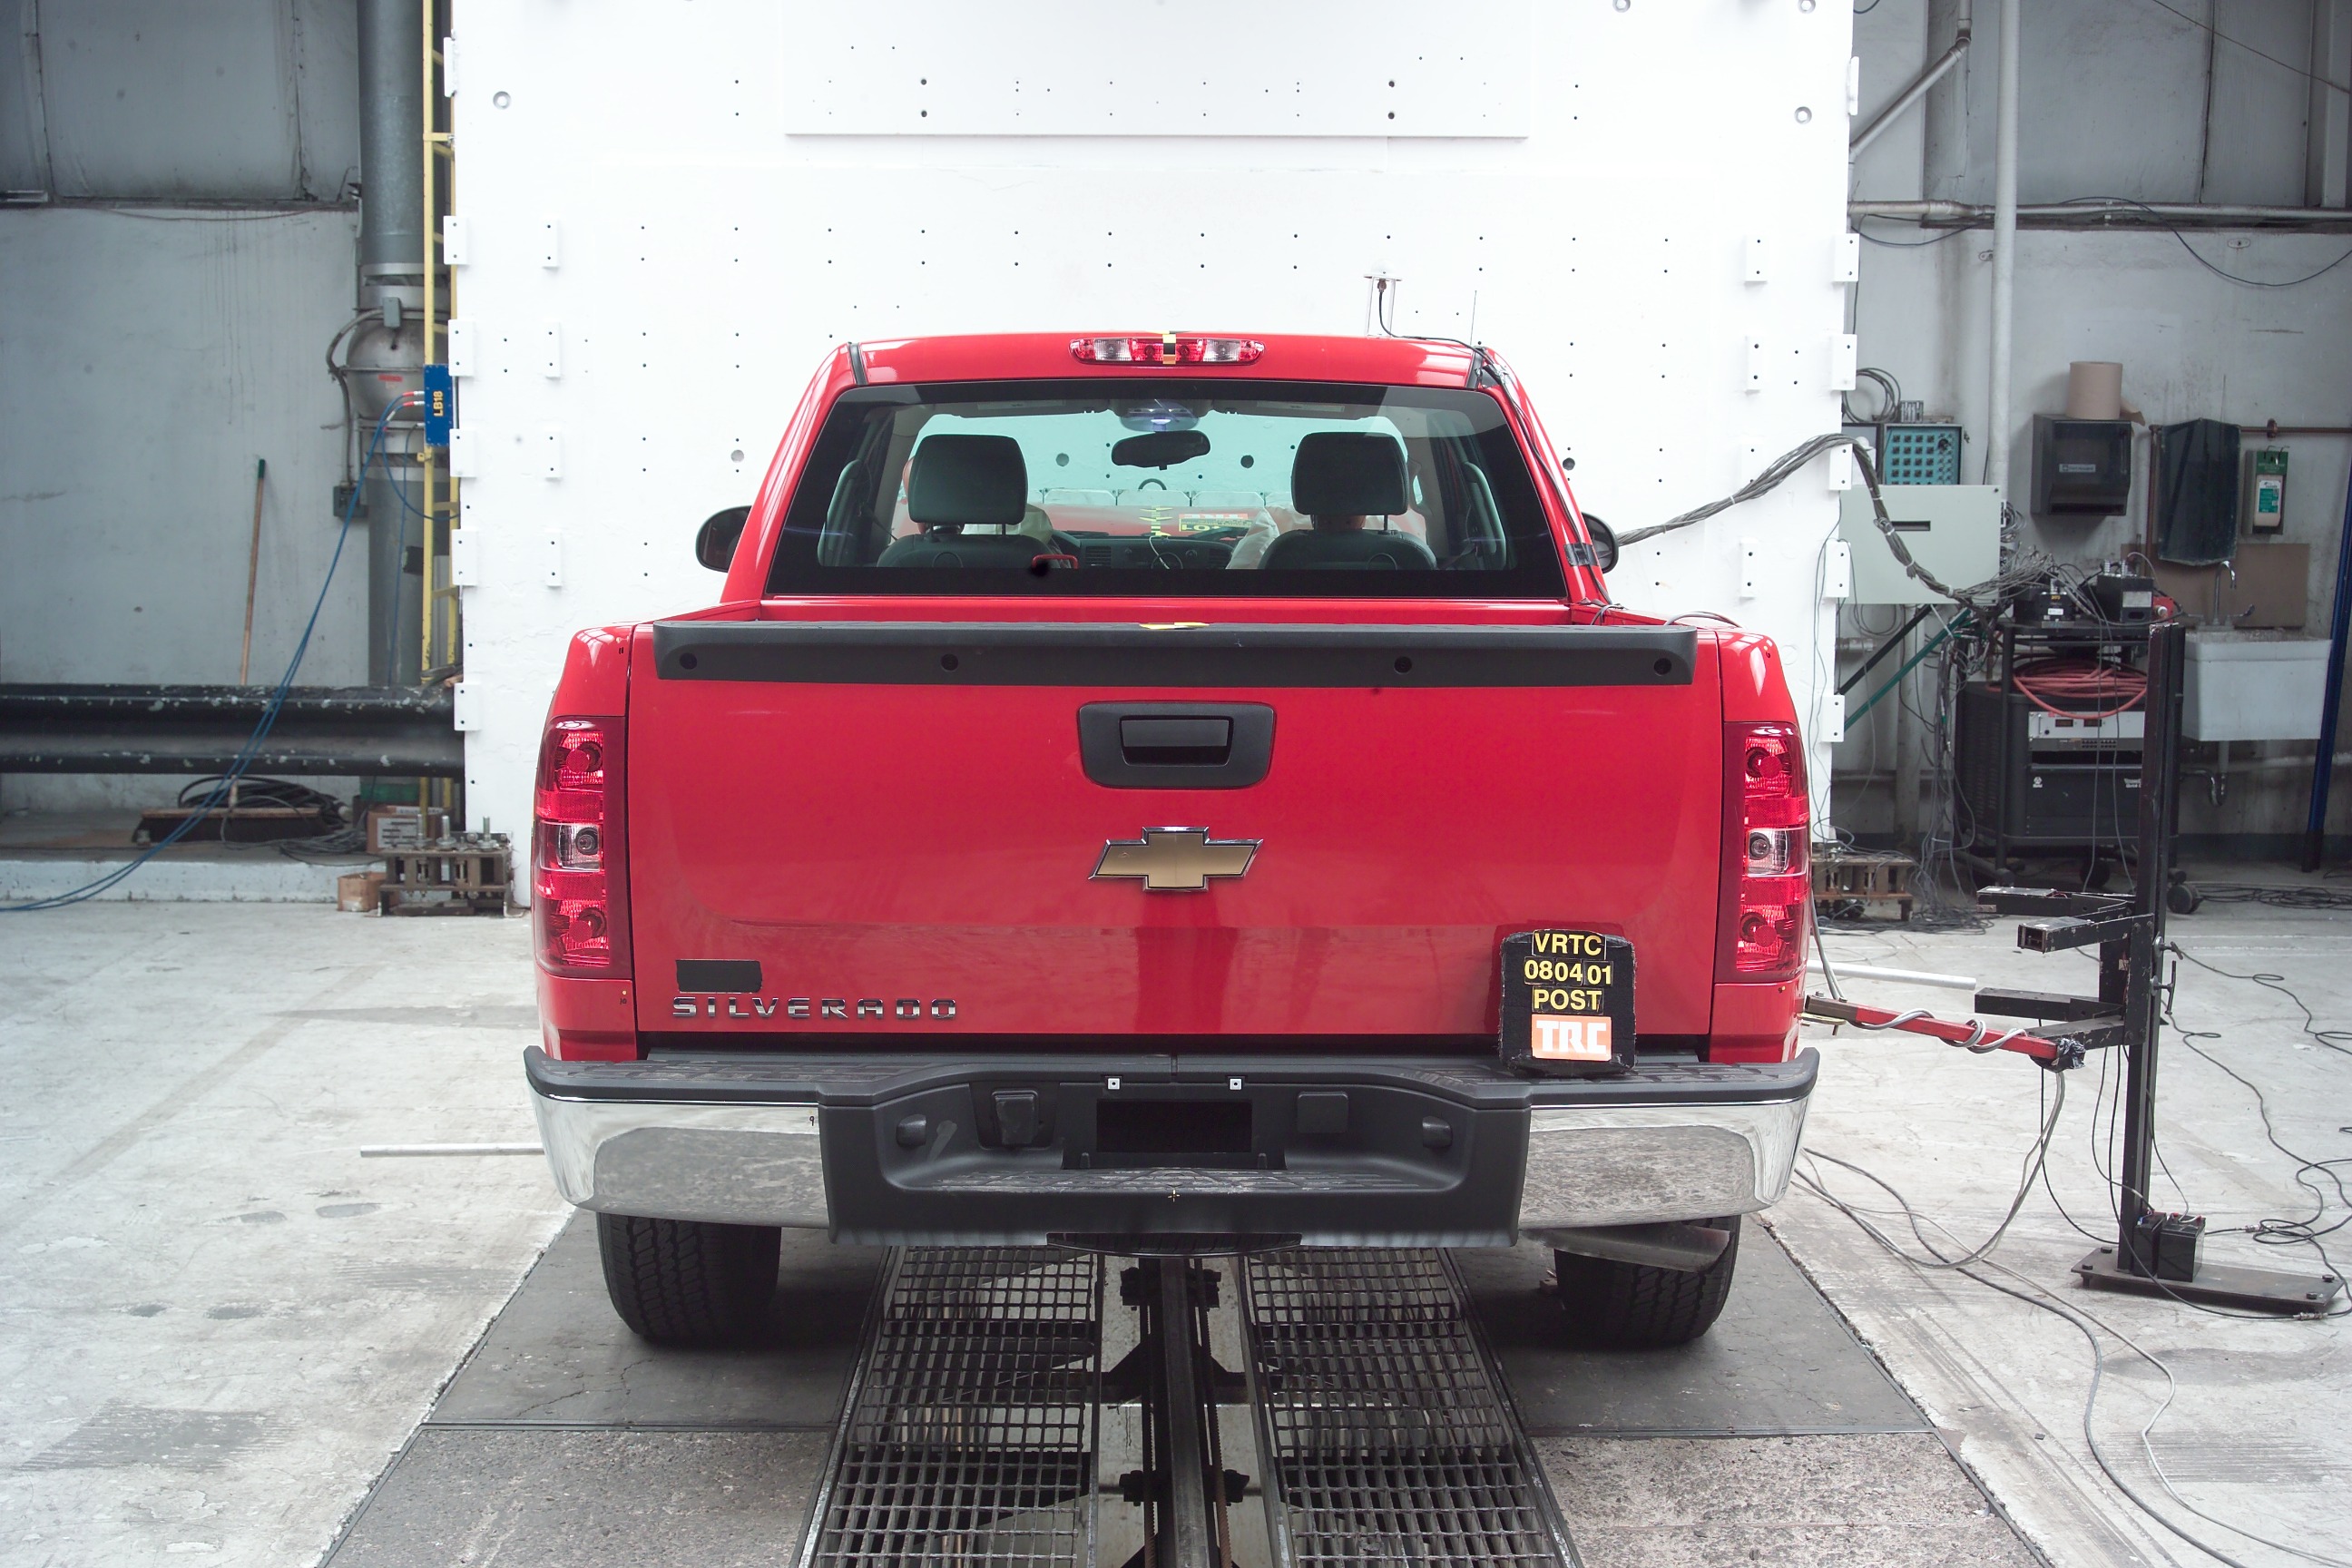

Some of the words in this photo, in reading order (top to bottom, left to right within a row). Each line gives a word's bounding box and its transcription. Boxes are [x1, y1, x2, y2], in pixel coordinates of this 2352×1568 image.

[1534, 933, 1602, 956] VRTC
[672, 996, 956, 1019] SILVERADO
[1534, 989, 1602, 1011] POST
[1536, 1020, 1608, 1054] TRC
[808, 1115, 815, 1127] 9
